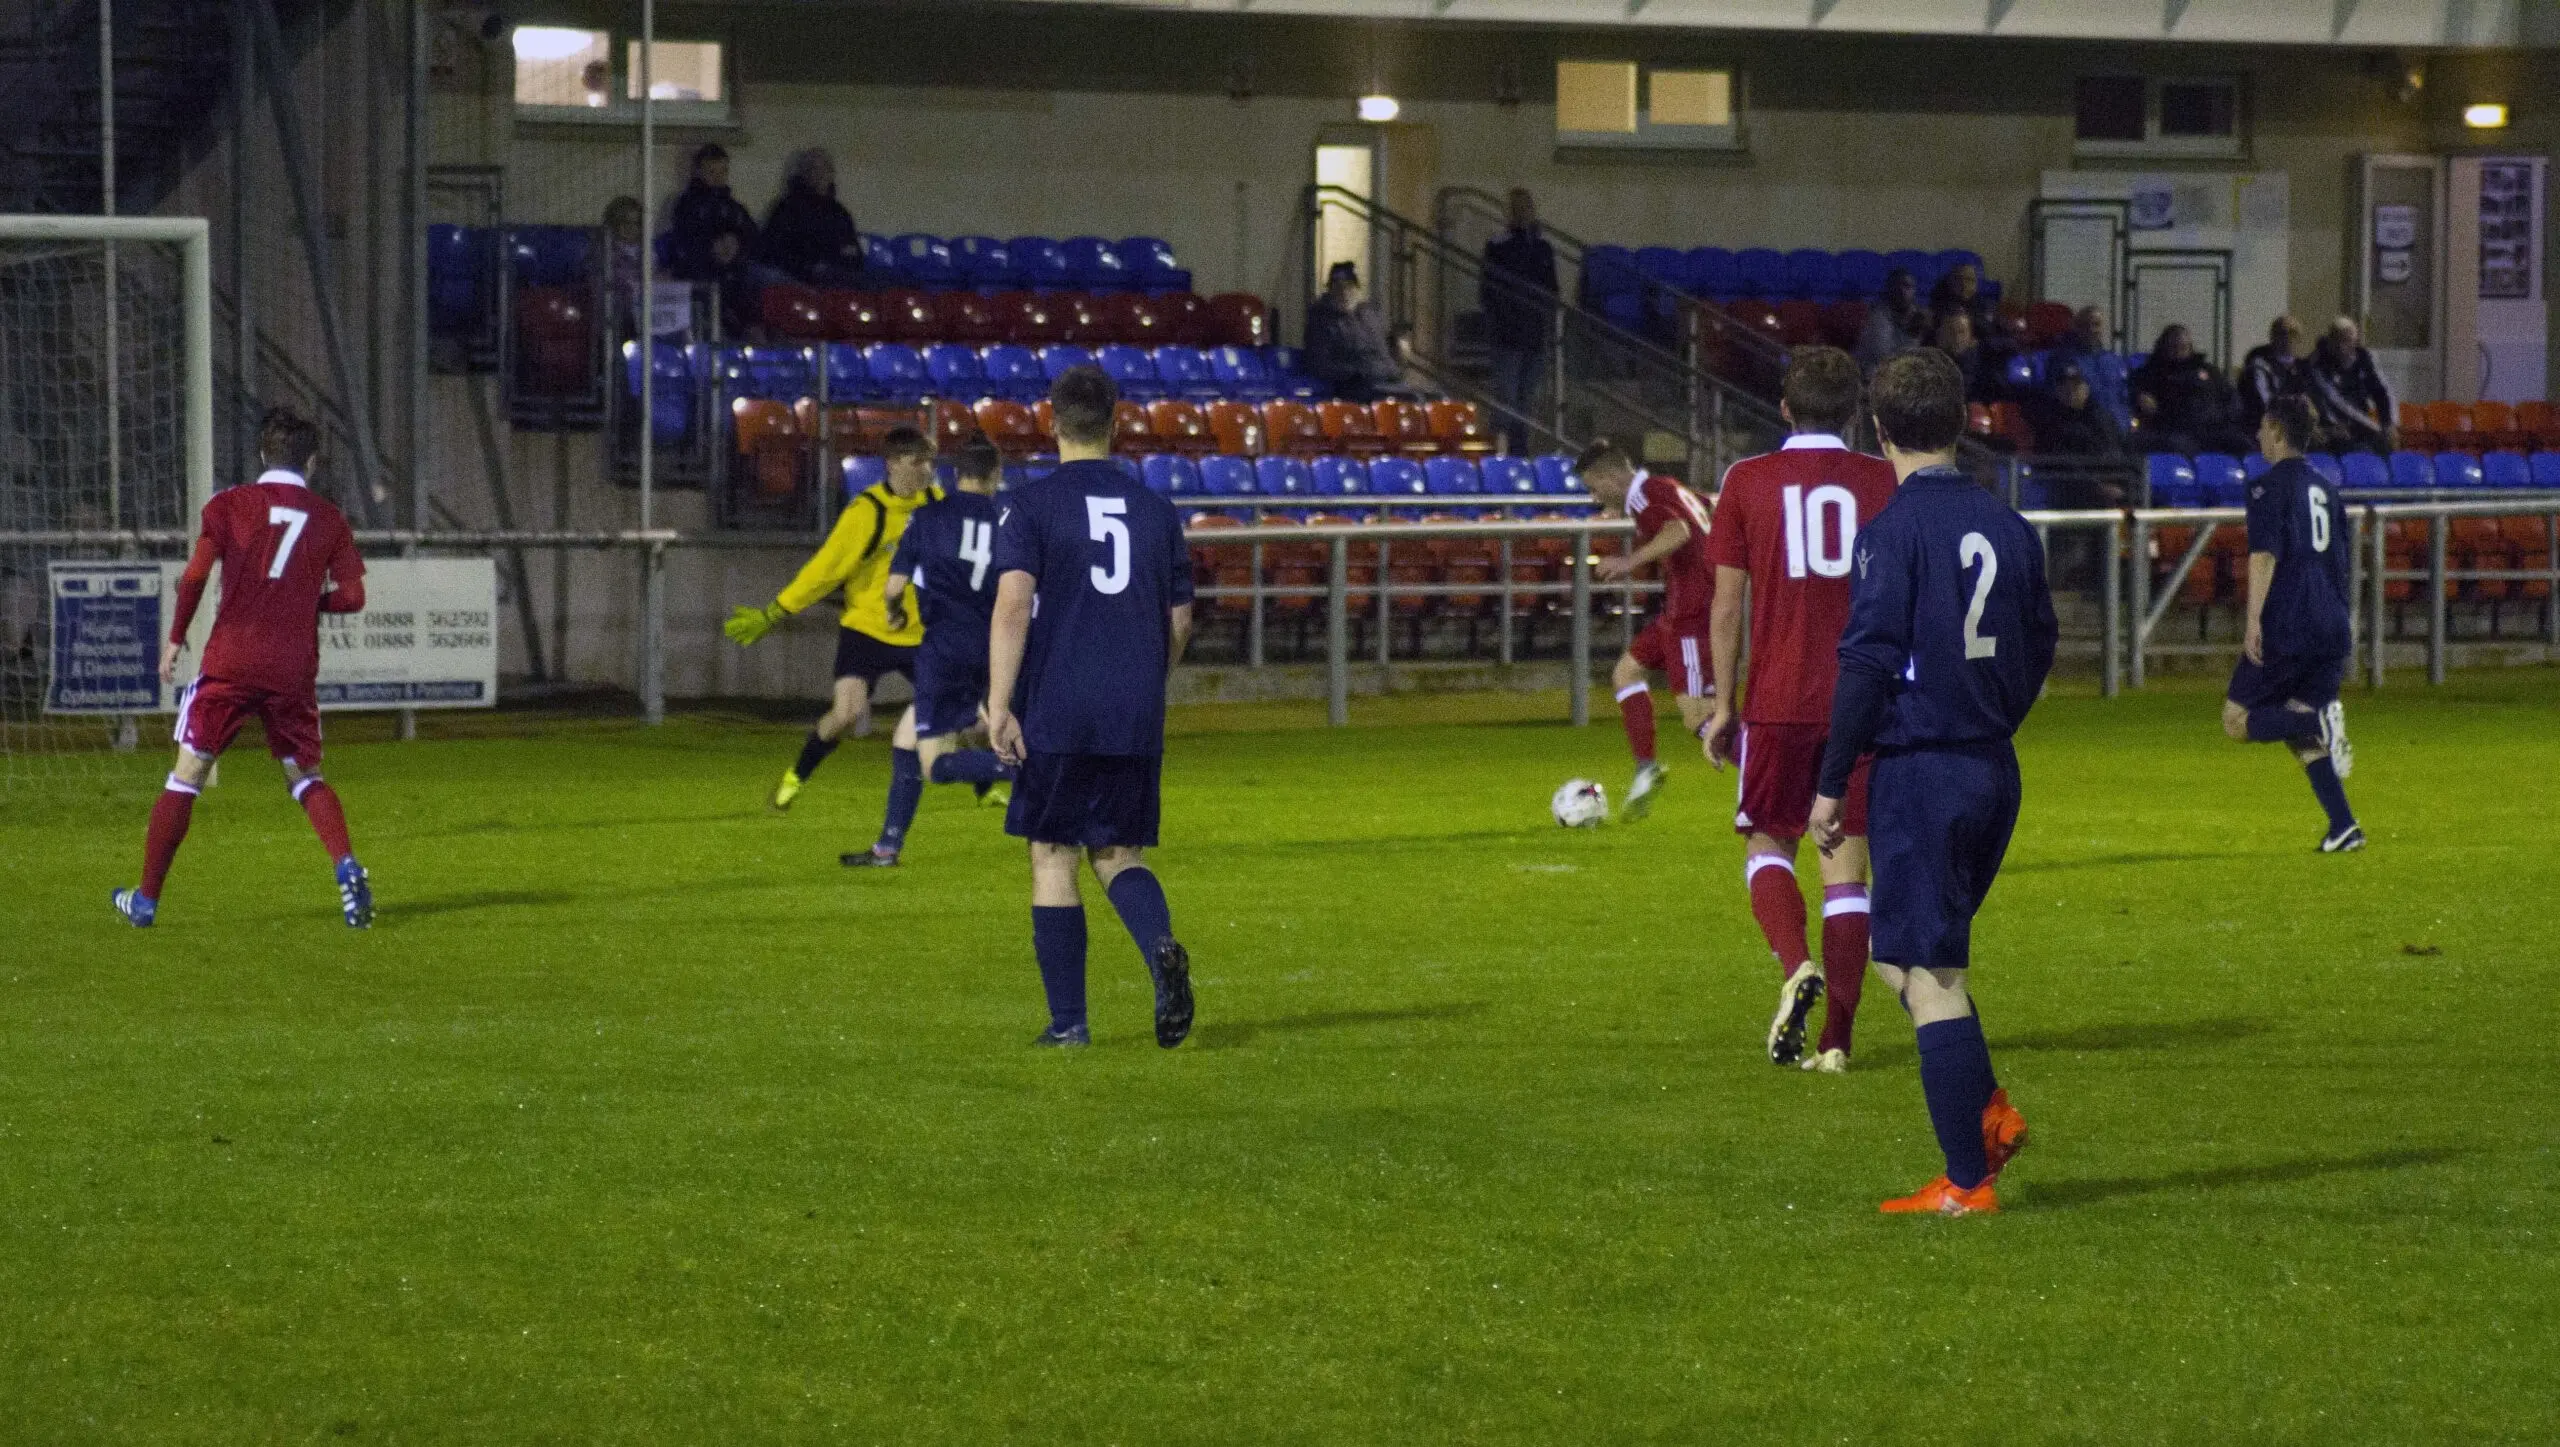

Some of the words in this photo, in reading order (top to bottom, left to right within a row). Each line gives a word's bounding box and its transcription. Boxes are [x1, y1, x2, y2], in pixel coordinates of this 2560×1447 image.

[269, 506, 308, 578] 7
[959, 517, 992, 591] 4
[1085, 495, 1131, 595] 5
[1783, 484, 1857, 578] 10
[2308, 485, 2330, 552] 6
[1959, 531, 1998, 660] 2
